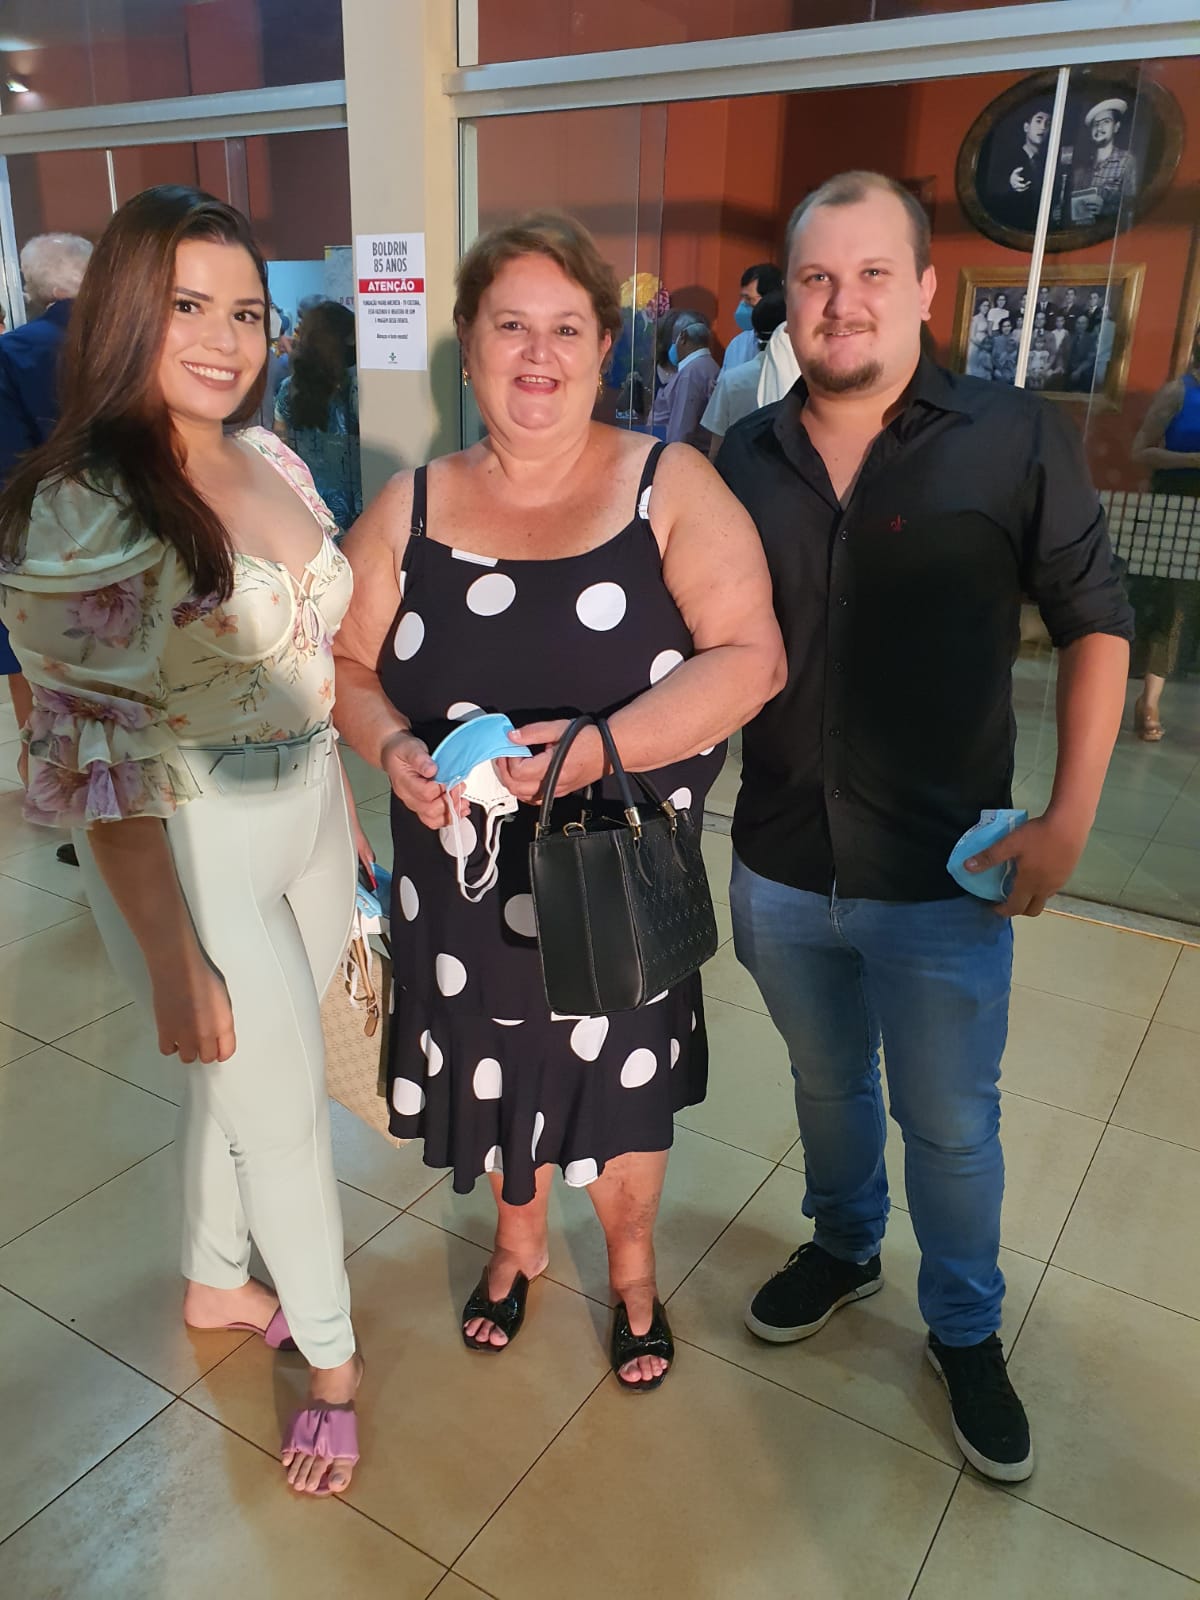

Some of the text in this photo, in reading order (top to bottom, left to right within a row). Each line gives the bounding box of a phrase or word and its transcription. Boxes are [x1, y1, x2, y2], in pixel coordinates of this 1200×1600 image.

[372, 240, 407, 256] BOLDRIN
[373, 257, 408, 272] 85 ANOS
[367, 278, 415, 292] ATENÇÃO
